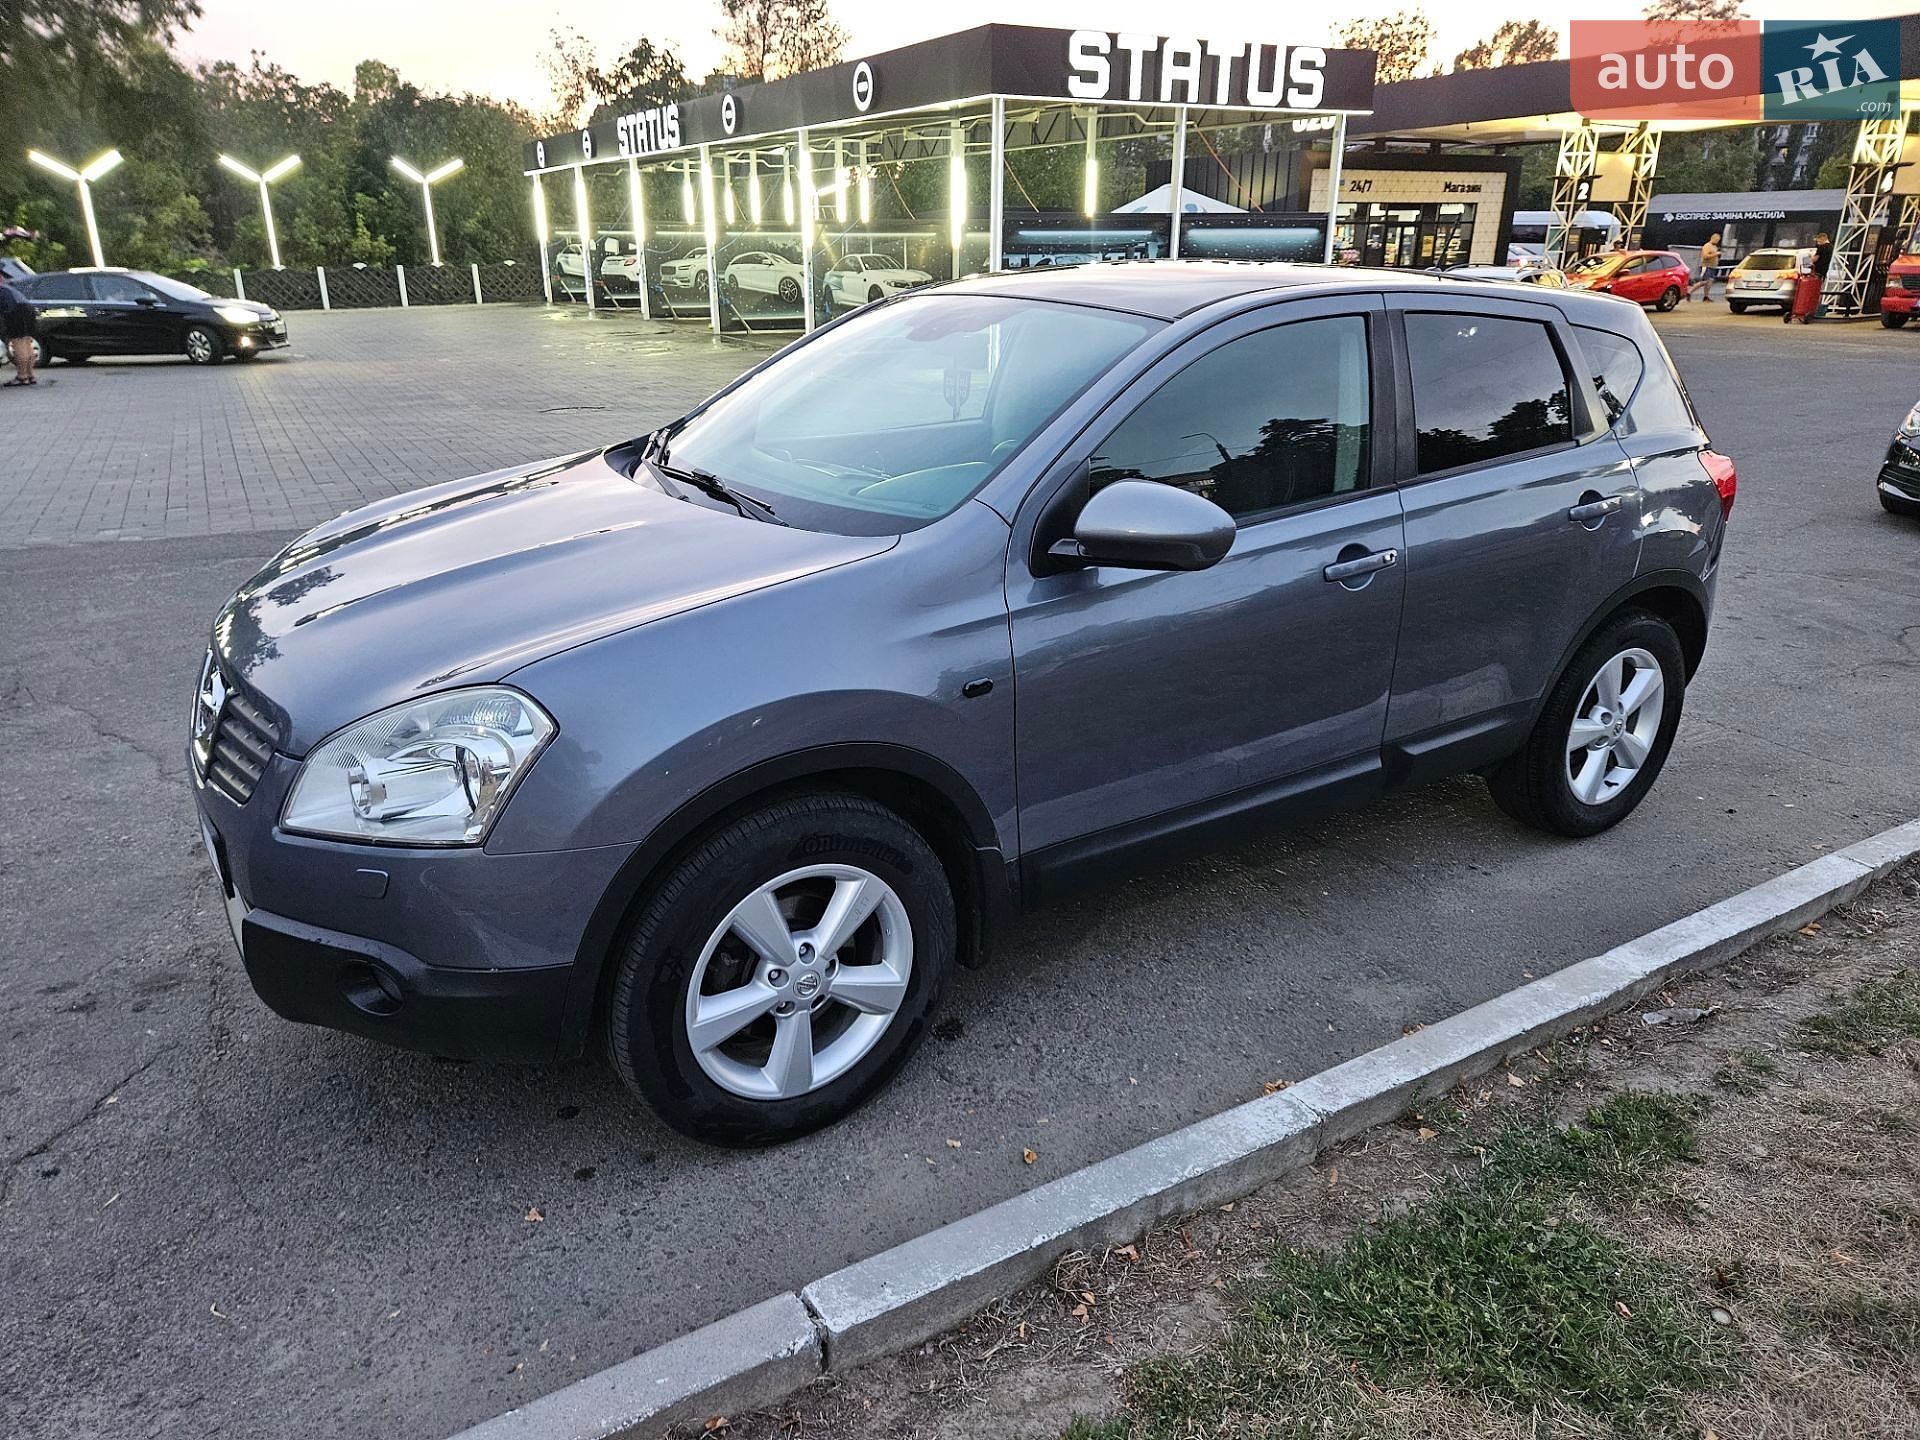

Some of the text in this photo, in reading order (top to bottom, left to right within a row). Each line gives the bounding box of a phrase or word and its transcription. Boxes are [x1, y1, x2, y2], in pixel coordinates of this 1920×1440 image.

[1068, 30, 1326, 109] STATUS
[617, 103, 680, 157] STATUS
[1350, 179, 1373, 193] 24/7
[1443, 181, 1482, 193] Магазин
[1577, 182, 1590, 200] 2
[1675, 211, 1786, 221] ЕКСПРЕС ЗАМІНА МАСТИЛА
